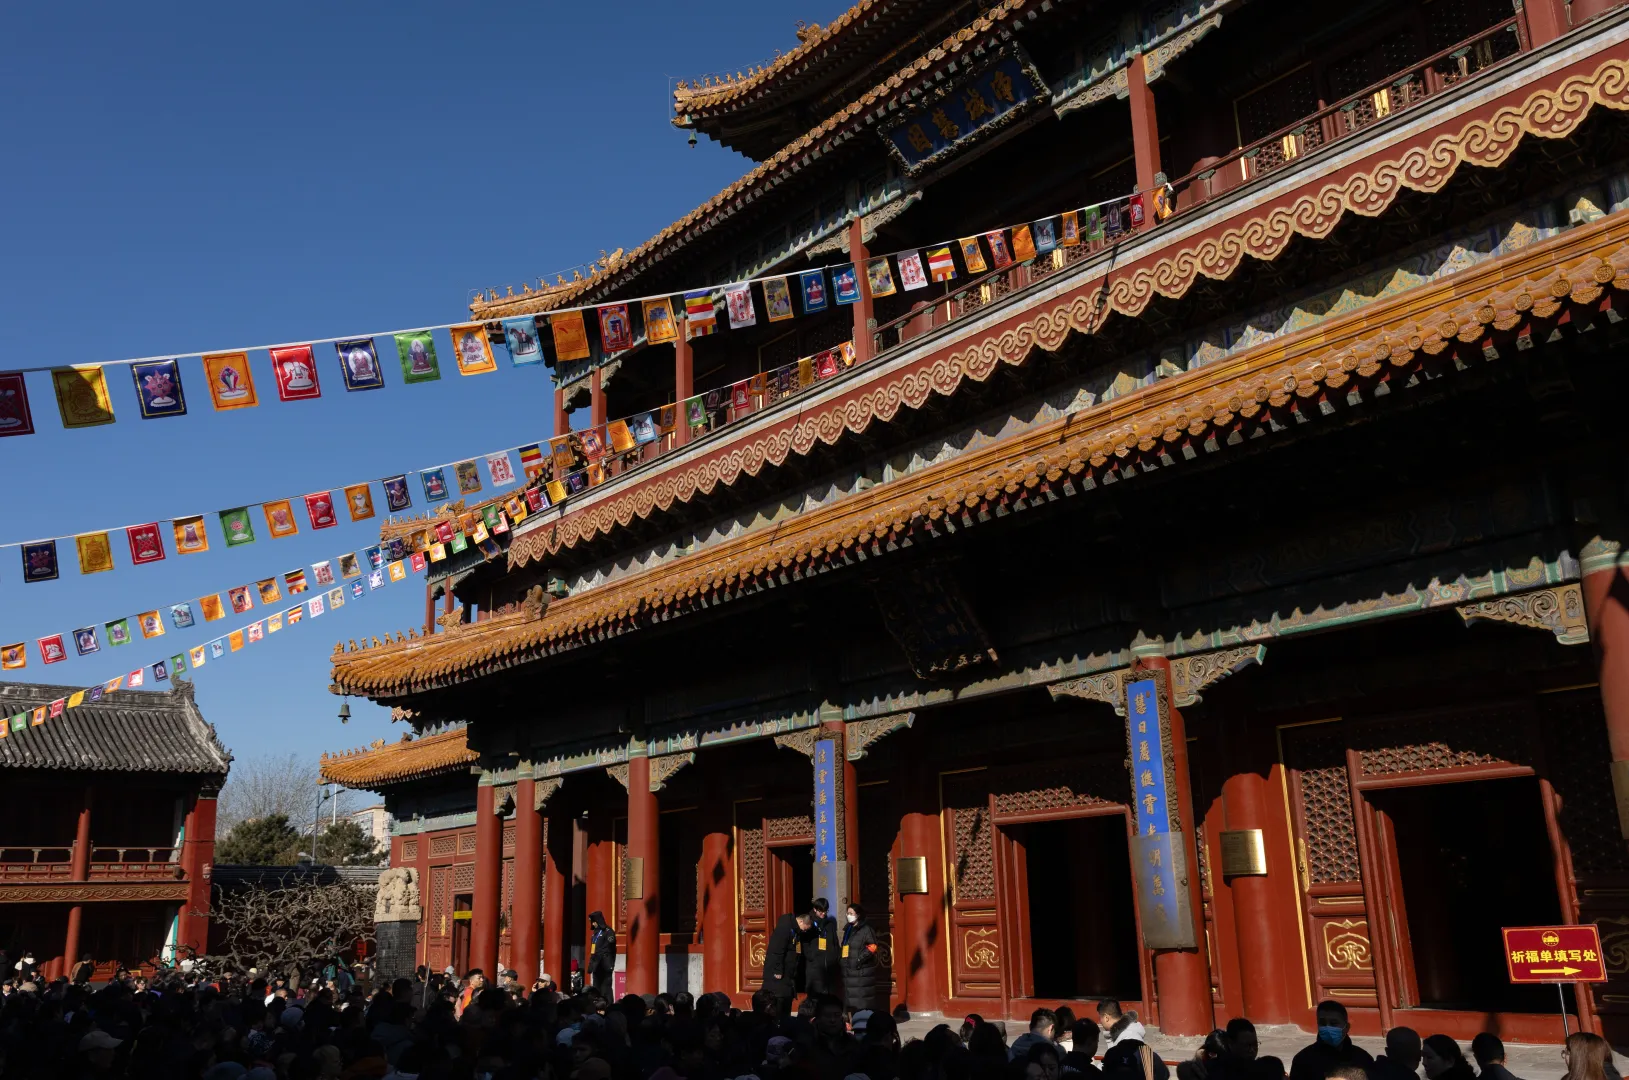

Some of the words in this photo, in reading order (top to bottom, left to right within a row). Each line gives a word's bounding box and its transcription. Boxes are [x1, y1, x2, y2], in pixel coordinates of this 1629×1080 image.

[1511, 949, 1598, 964] 祈福单填写处
